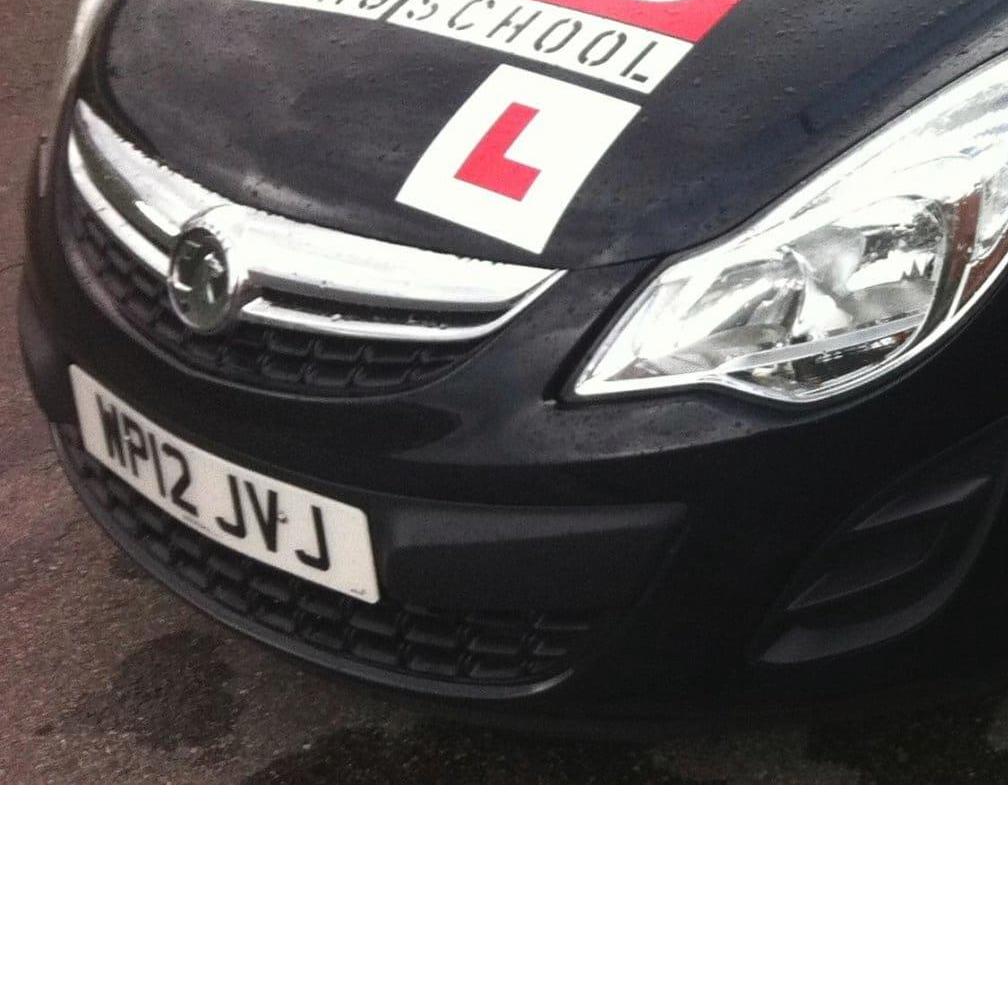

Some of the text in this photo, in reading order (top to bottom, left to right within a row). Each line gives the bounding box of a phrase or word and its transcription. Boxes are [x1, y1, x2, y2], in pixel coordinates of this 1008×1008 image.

[454, 102, 541, 202] L
[95, 392, 331, 573] WP12 JVJ
